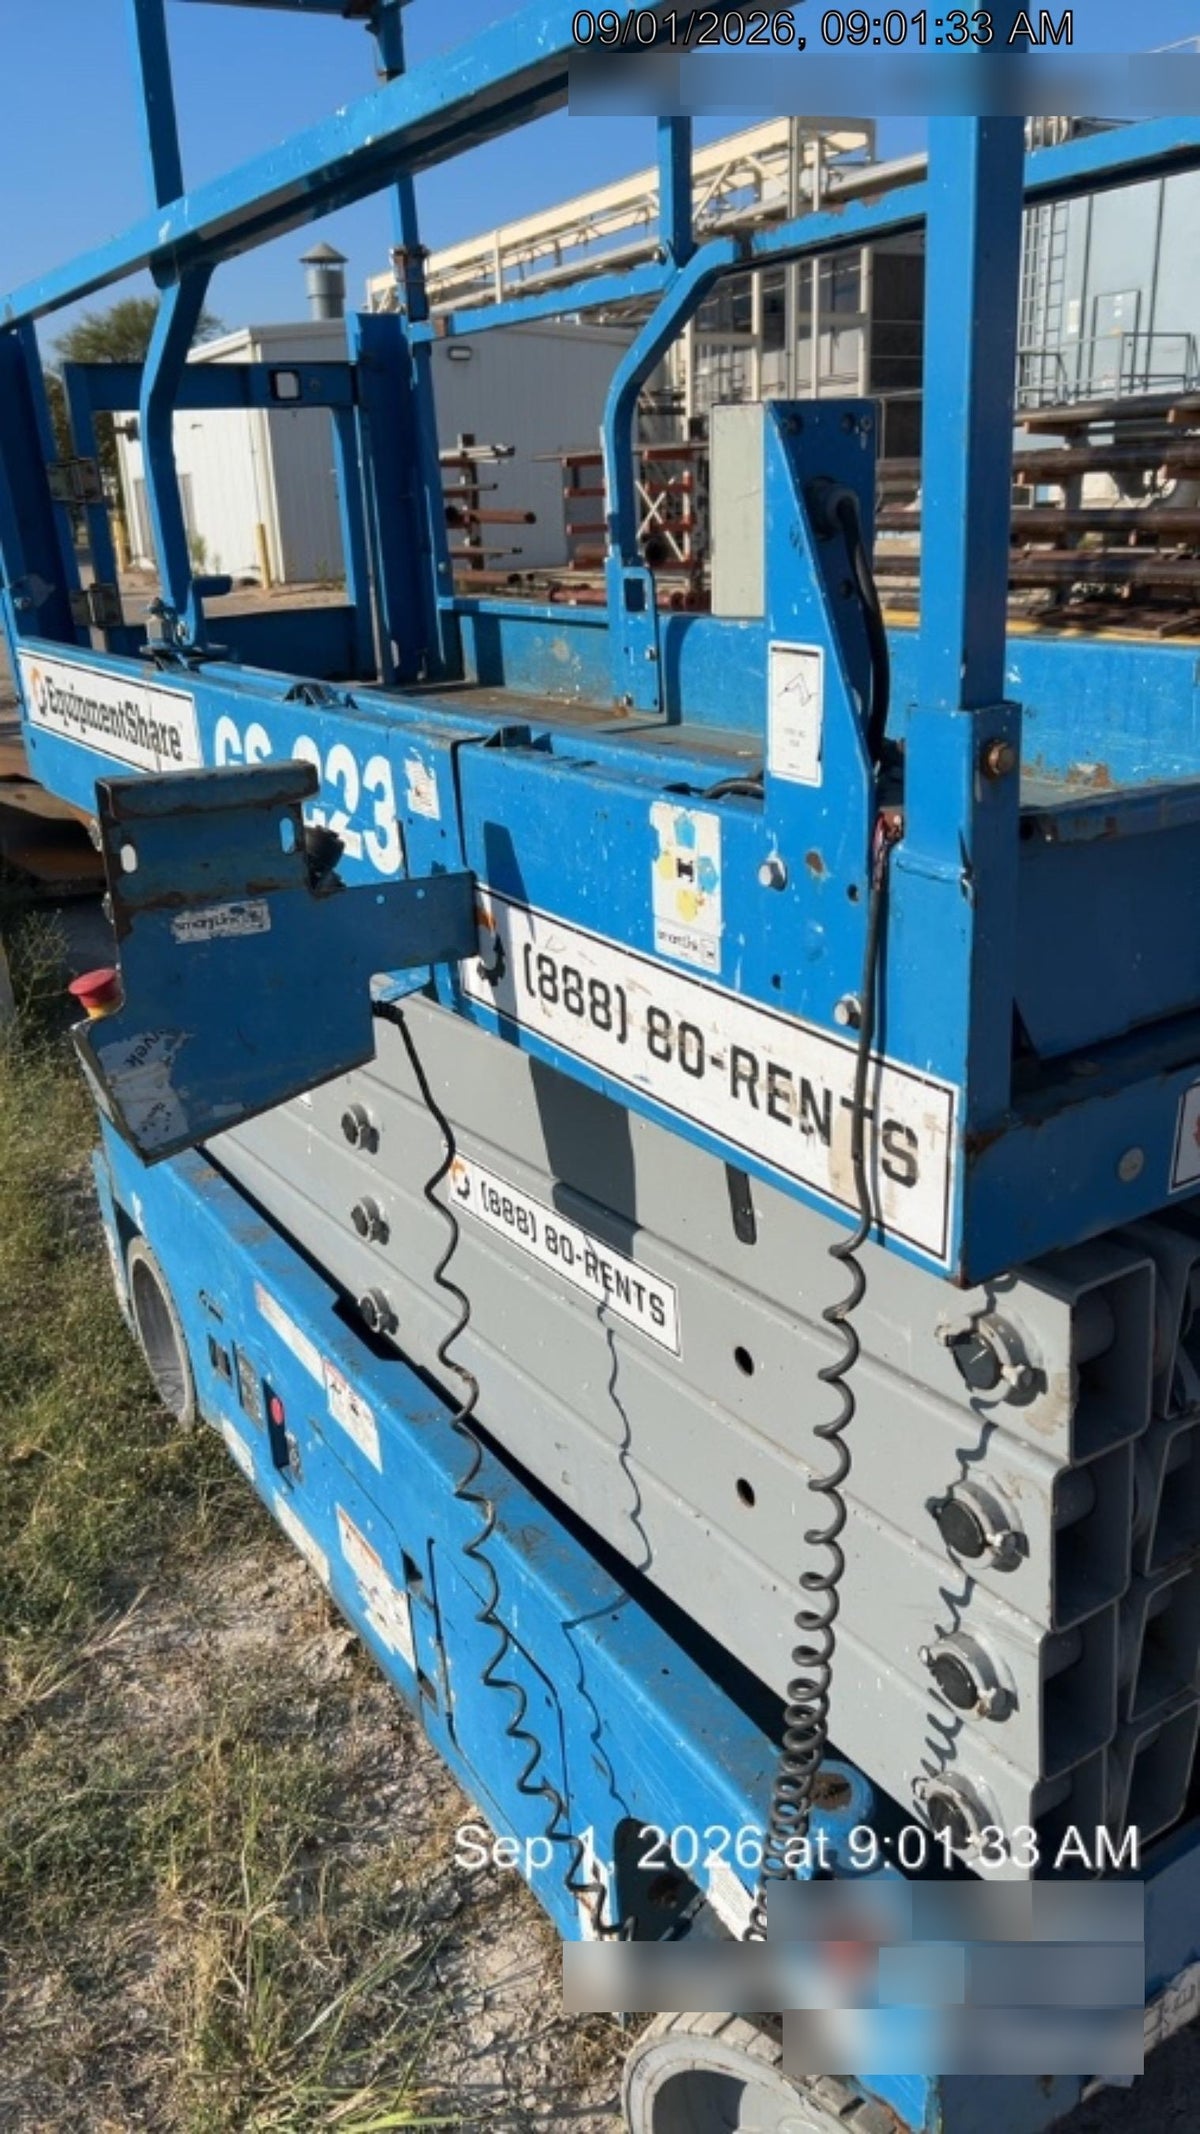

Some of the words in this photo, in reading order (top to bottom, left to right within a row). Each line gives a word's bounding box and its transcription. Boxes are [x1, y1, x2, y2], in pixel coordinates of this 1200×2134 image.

[45, 674, 184, 763] EquipmentShare
[522, 941, 629, 1045] (888)
[480, 1180, 538, 1244] (888)
[544, 1224, 666, 1327] 80-RENTS
